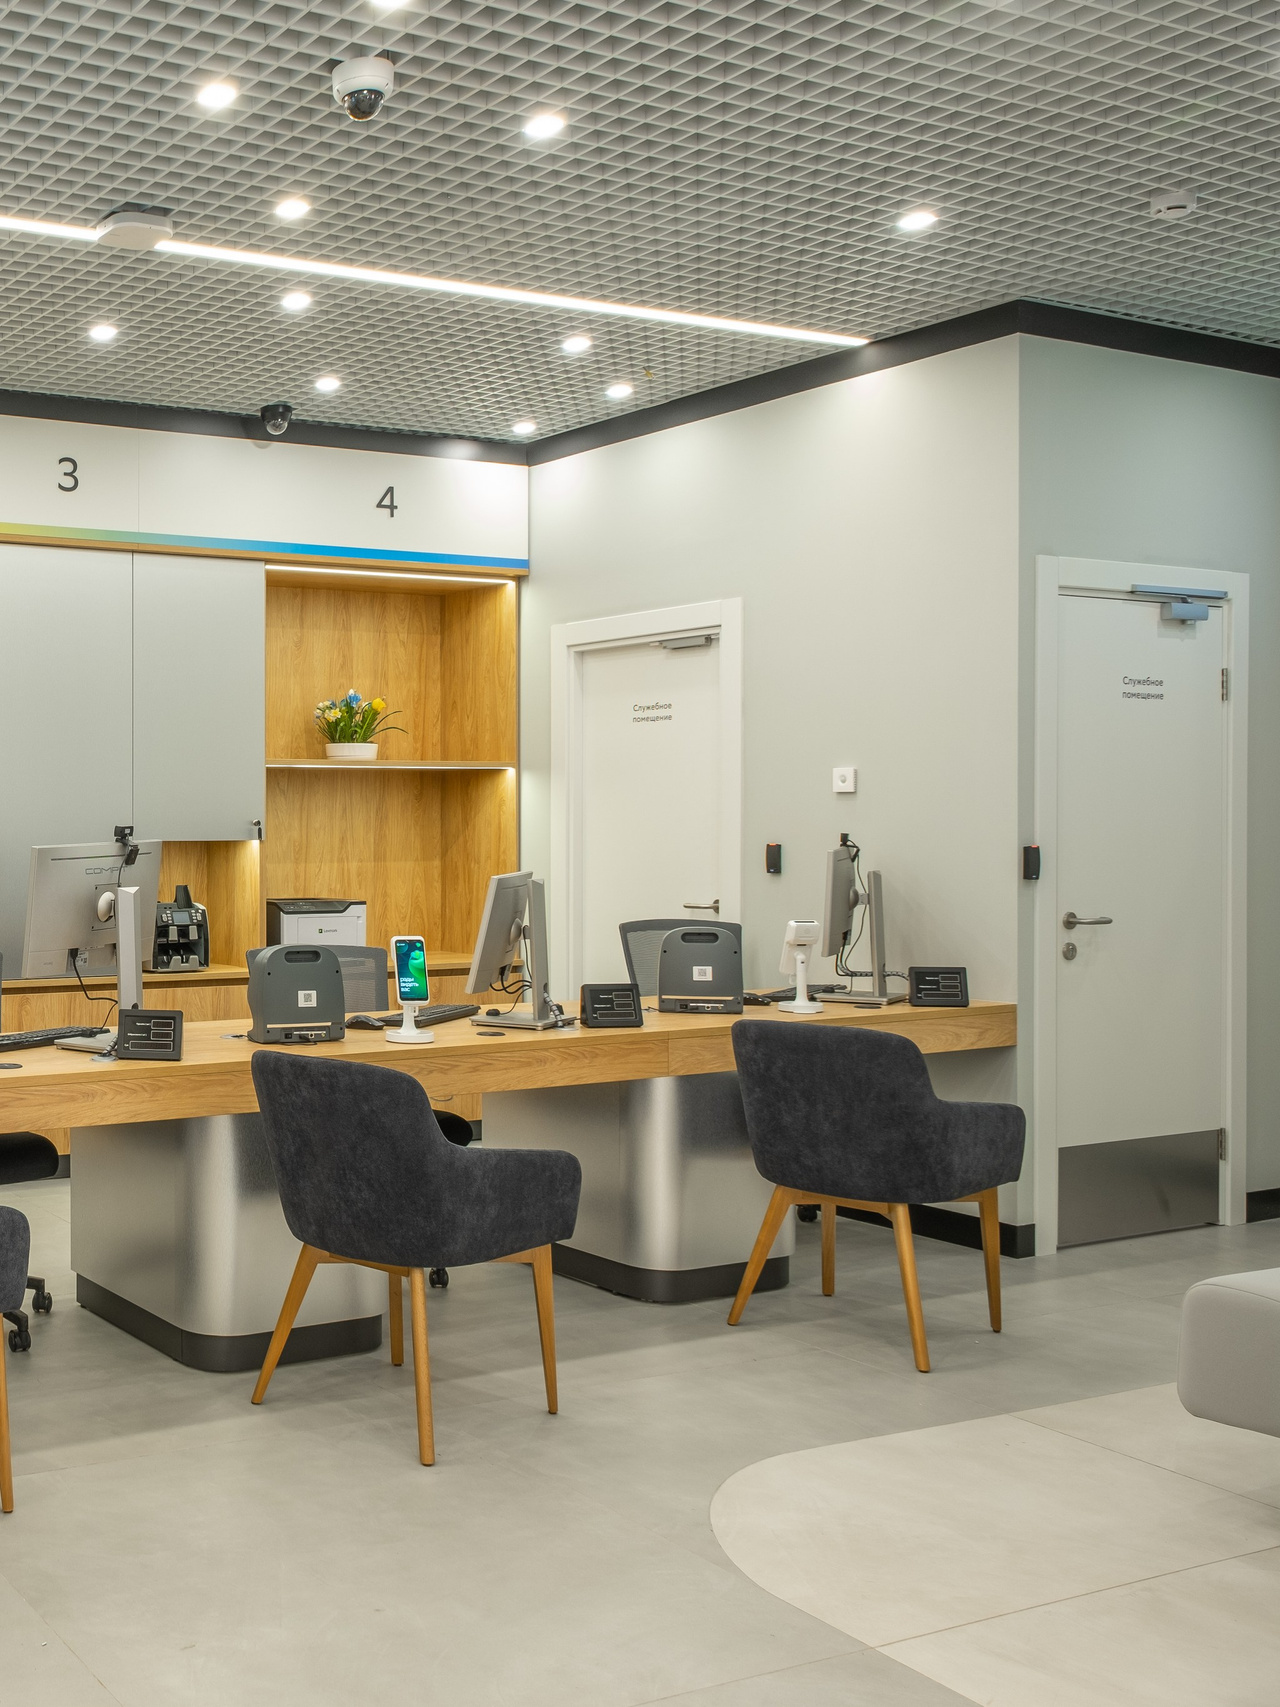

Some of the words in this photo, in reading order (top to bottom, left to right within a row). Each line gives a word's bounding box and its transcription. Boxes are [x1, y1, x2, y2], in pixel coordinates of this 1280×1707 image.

[58, 456, 79, 493] 3
[376, 486, 398, 518] 4
[1123, 675, 1164, 687] Служебное
[1122, 691, 1164, 701] помещение
[632, 701, 673, 713] Служебное
[632, 714, 673, 723] помещение
